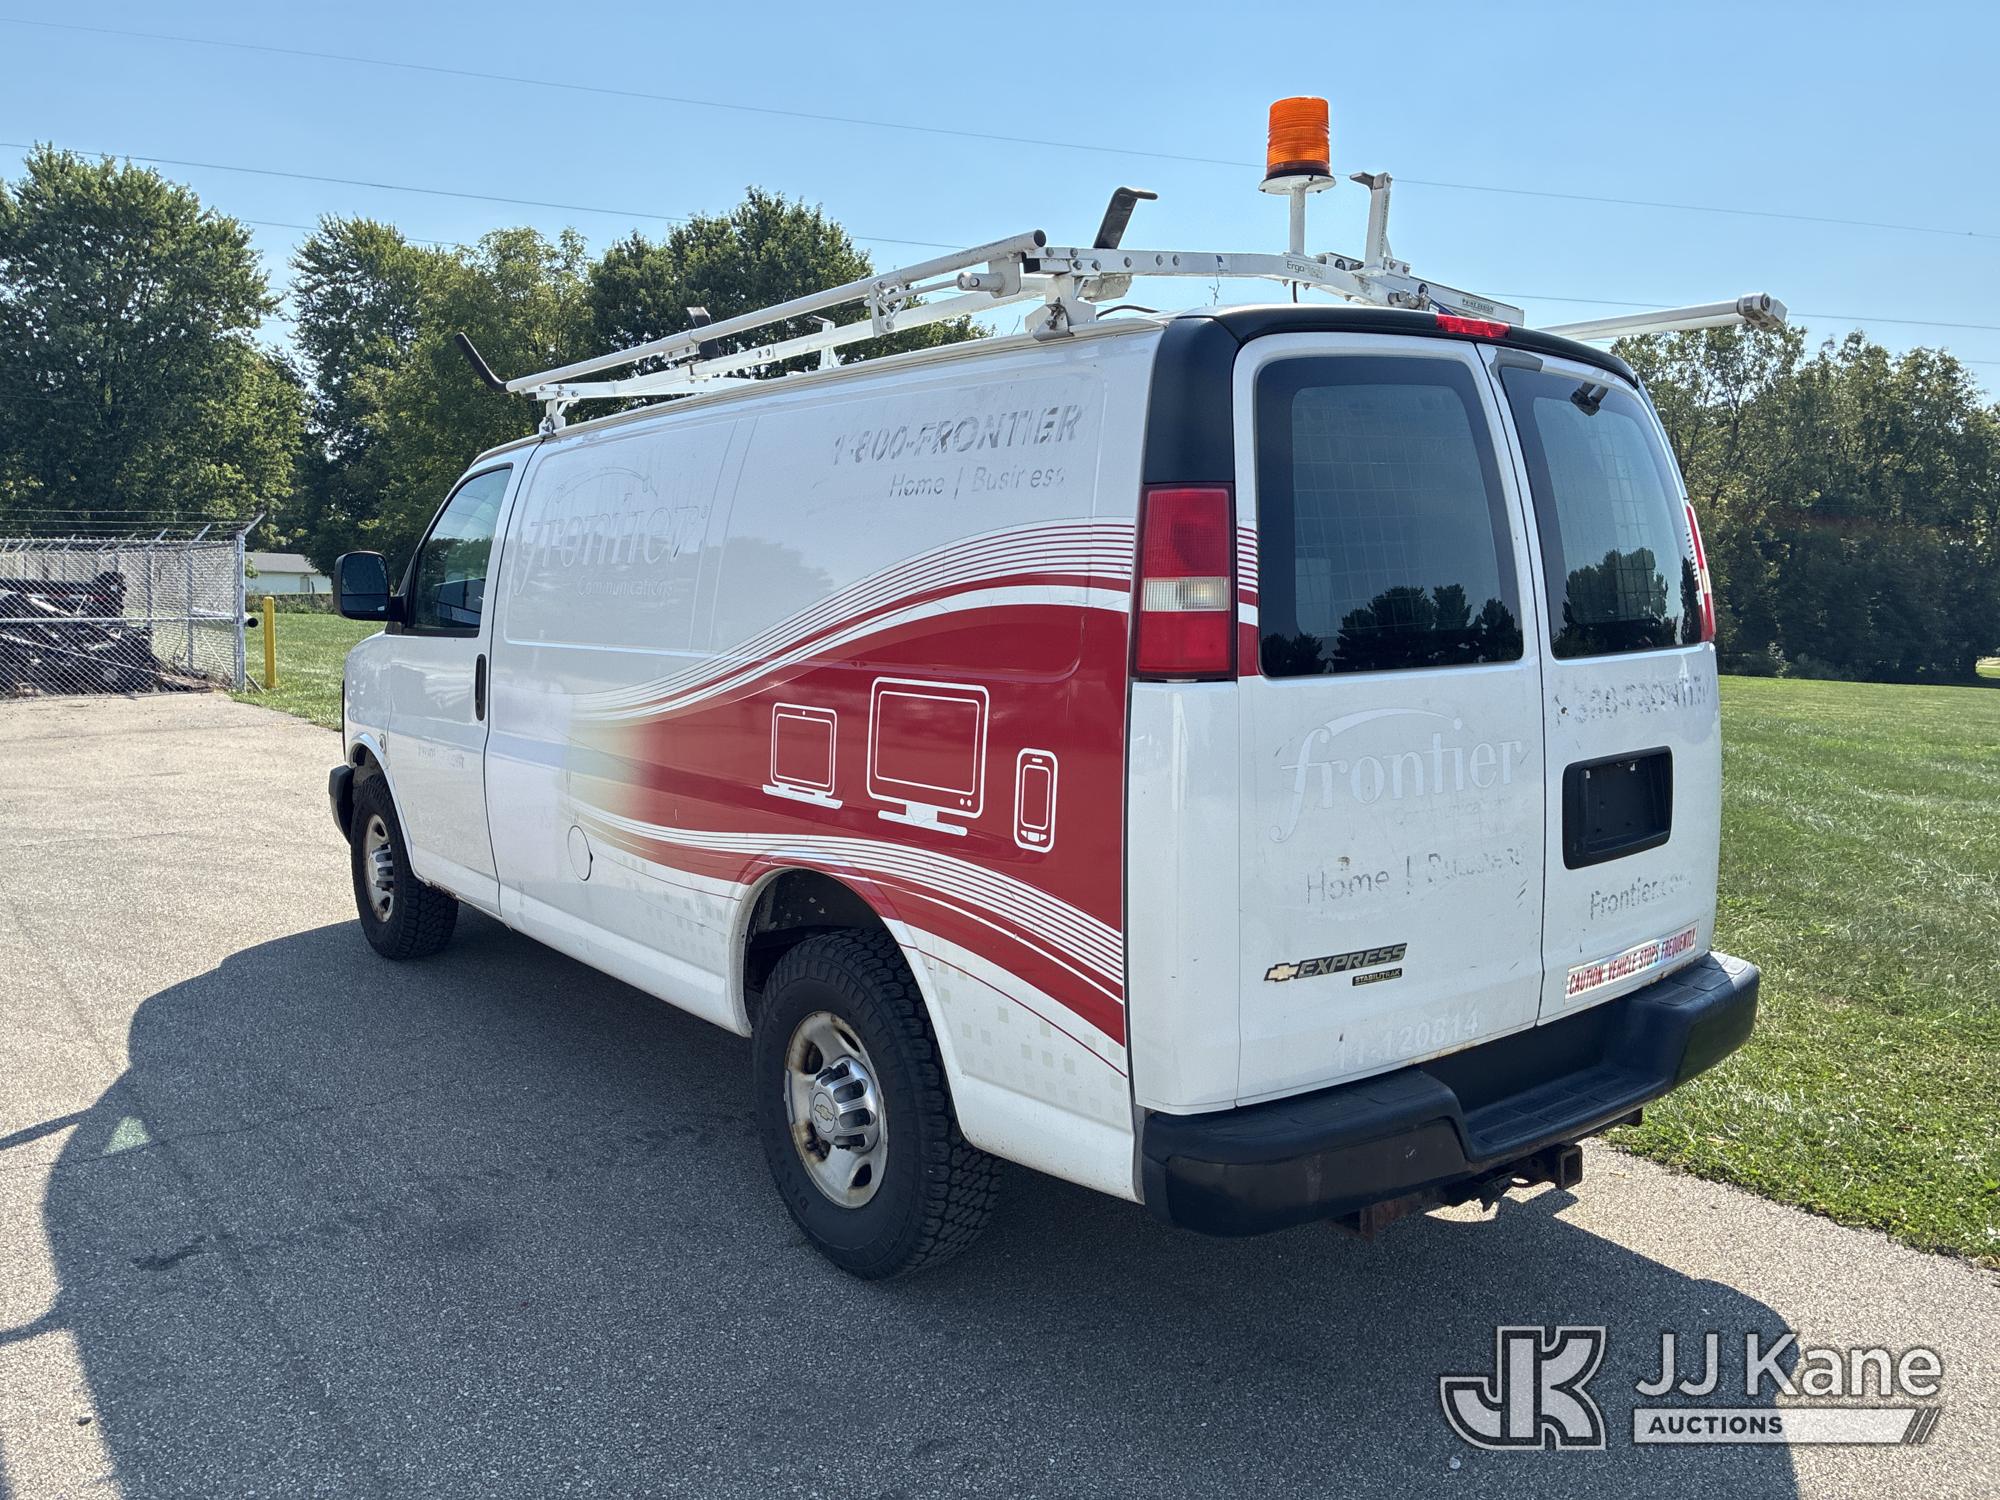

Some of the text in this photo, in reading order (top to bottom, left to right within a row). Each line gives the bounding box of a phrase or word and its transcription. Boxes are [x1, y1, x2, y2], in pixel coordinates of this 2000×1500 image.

[889, 473, 945, 498] Home
[1269, 718, 1523, 842] frontier
[1306, 870, 1391, 905] Home
[1299, 945, 1407, 977] EXPRESS
[1638, 944, 1659, 969] STOPS
[1661, 928, 1697, 960] FREQUENTLY
